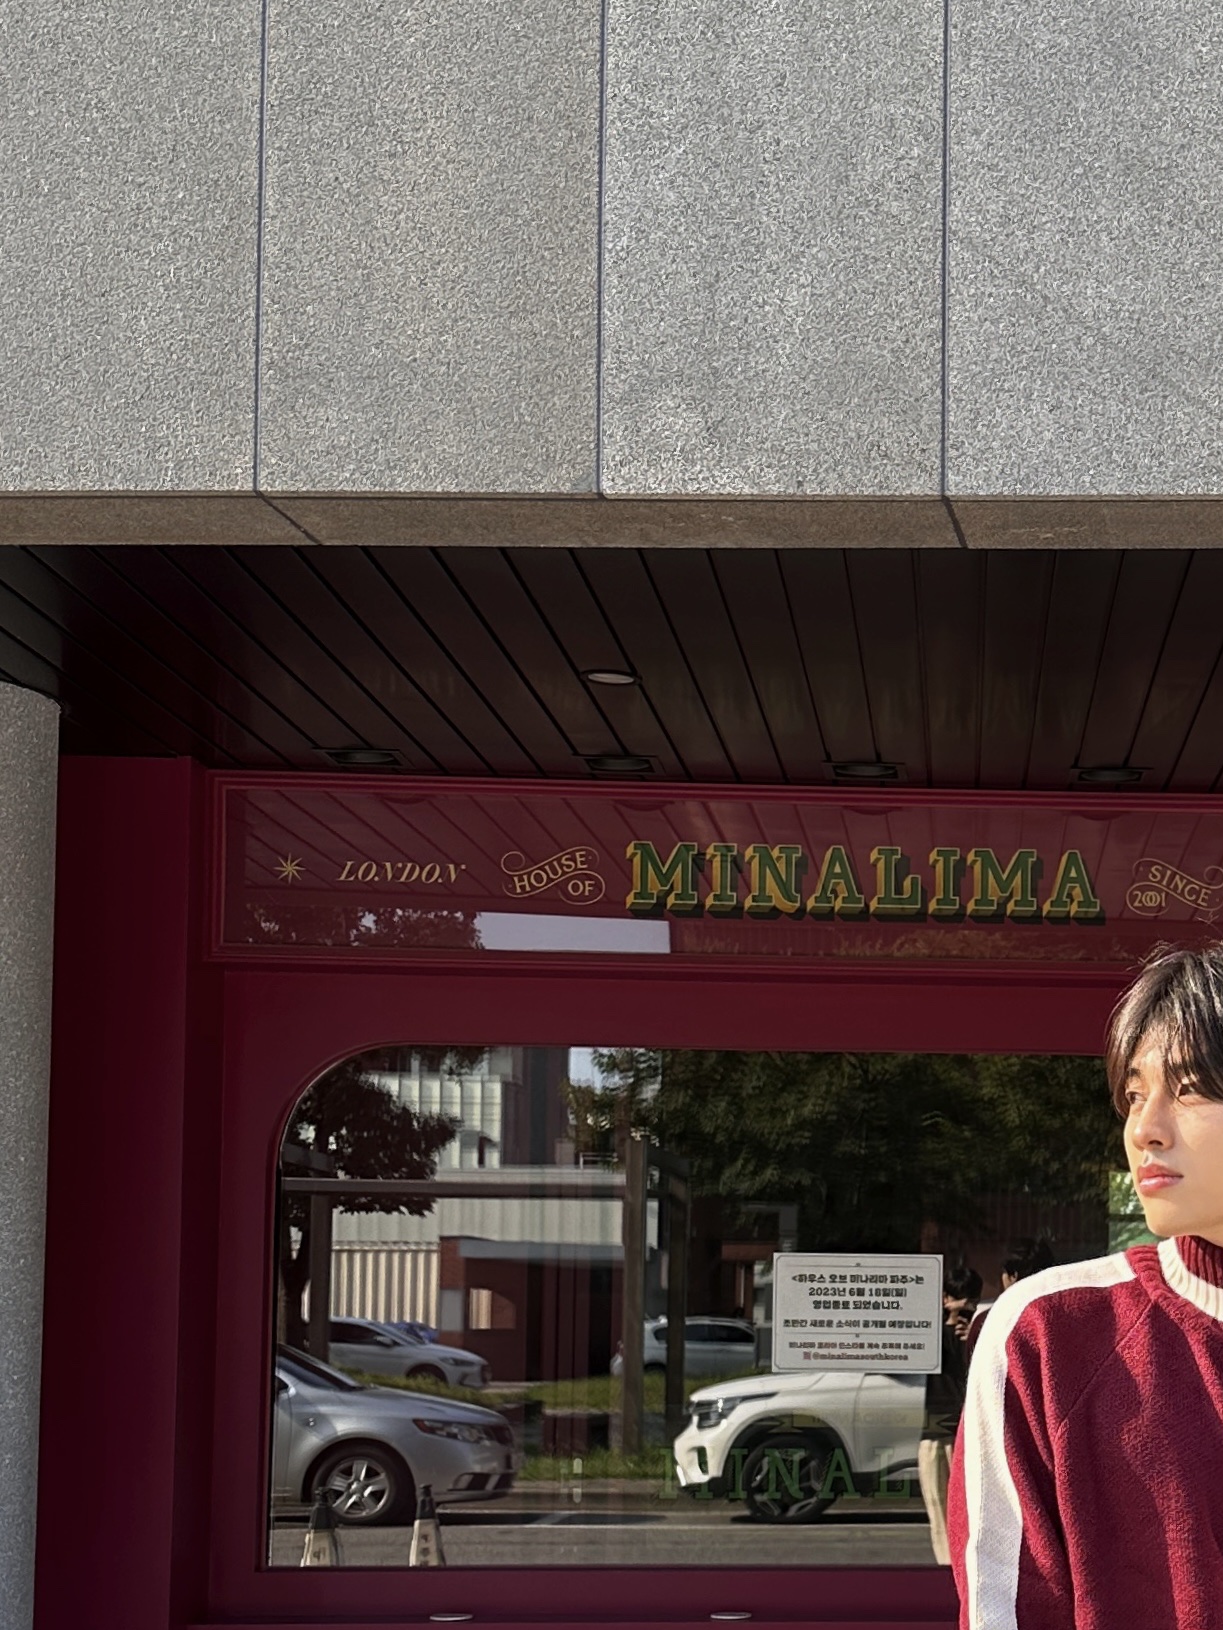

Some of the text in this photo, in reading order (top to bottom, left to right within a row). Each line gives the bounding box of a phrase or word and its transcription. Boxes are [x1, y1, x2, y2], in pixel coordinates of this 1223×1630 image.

[336, 861, 466, 884] LONDON
[513, 850, 588, 893] HOUSE
[625, 840, 1103, 919] MINALIMA
[567, 879, 595, 896] OF
[1148, 864, 1212, 907] SINCE
[829, 1274, 848, 1283] 오브
[808, 1287, 846, 1296] 2023년
